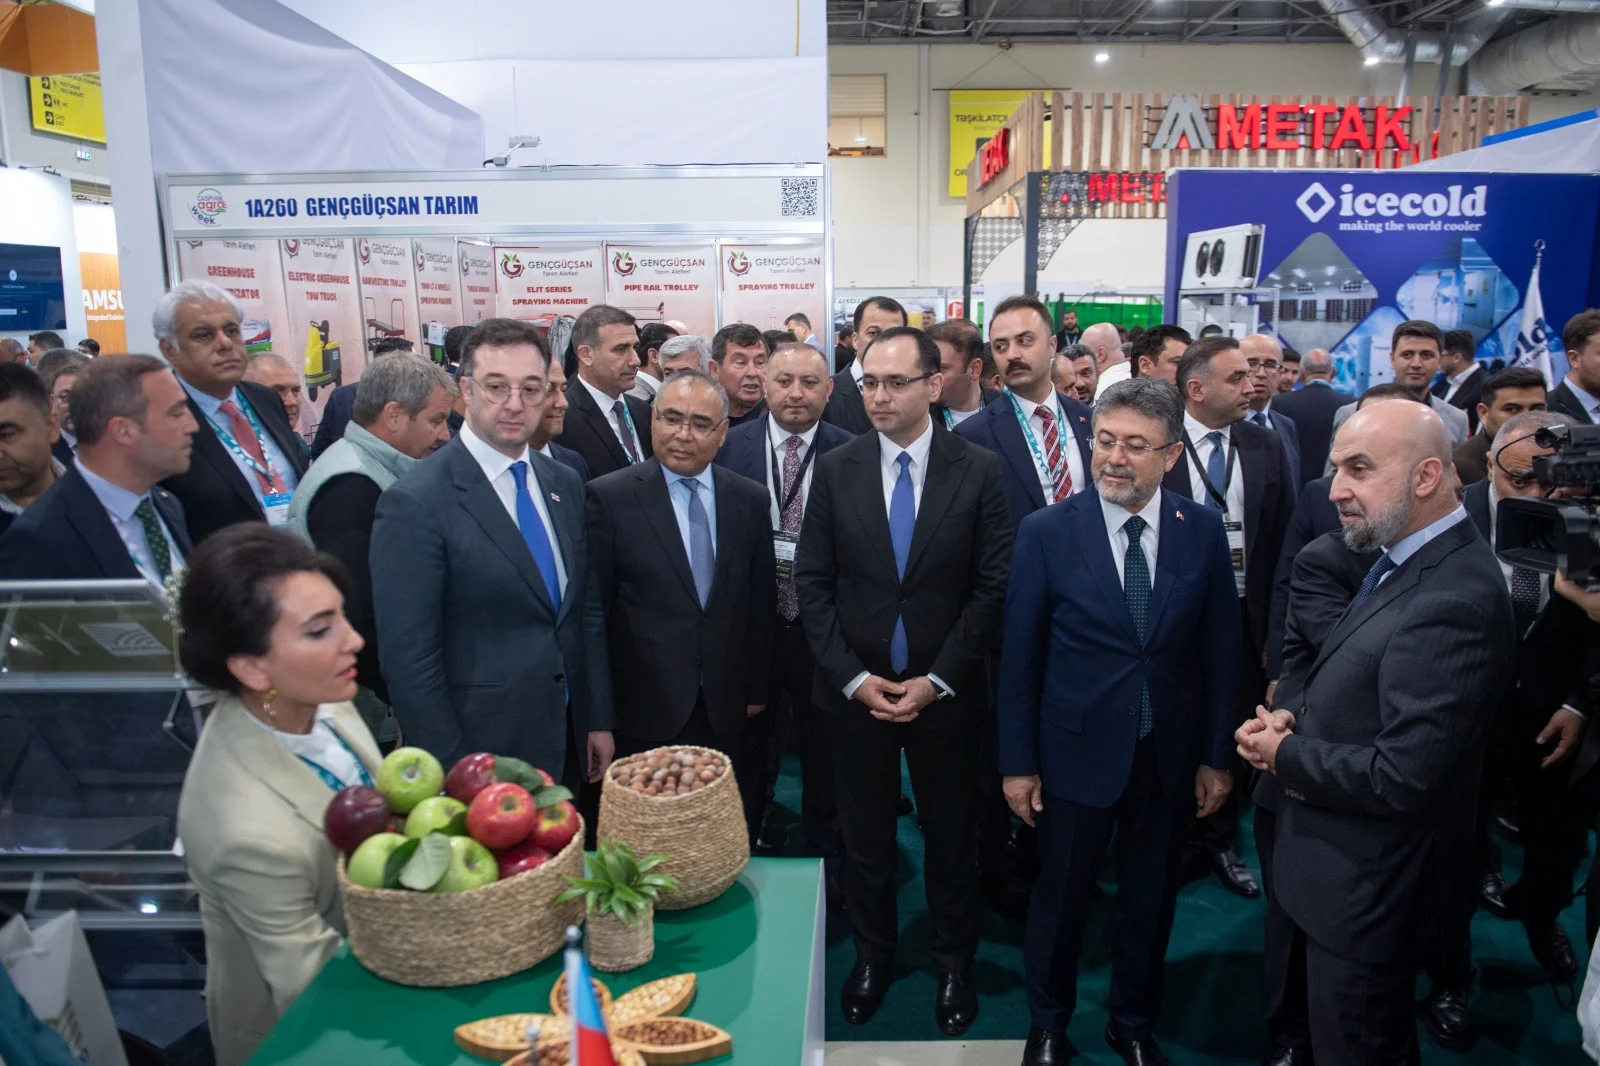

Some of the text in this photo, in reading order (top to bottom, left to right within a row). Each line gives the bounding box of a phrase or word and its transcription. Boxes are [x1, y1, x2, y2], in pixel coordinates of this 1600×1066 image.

[1216, 103, 1413, 150] METAK
[1088, 173, 1169, 203] MET
[245, 194, 479, 219] 1A260 GENÇGÜÇSAN TARIM
[1339, 183, 1488, 217] icecold
[1339, 220, 1482, 234] making the world cooler
[527, 259, 593, 272] GENÇGÜÇSAN
[640, 257, 705, 270] GENÇGÜÇSAN
[755, 255, 821, 269] GENÇGÜÇSAN
[207, 265, 256, 279] GREENHOUSE
[624, 284, 643, 292] PIPE
